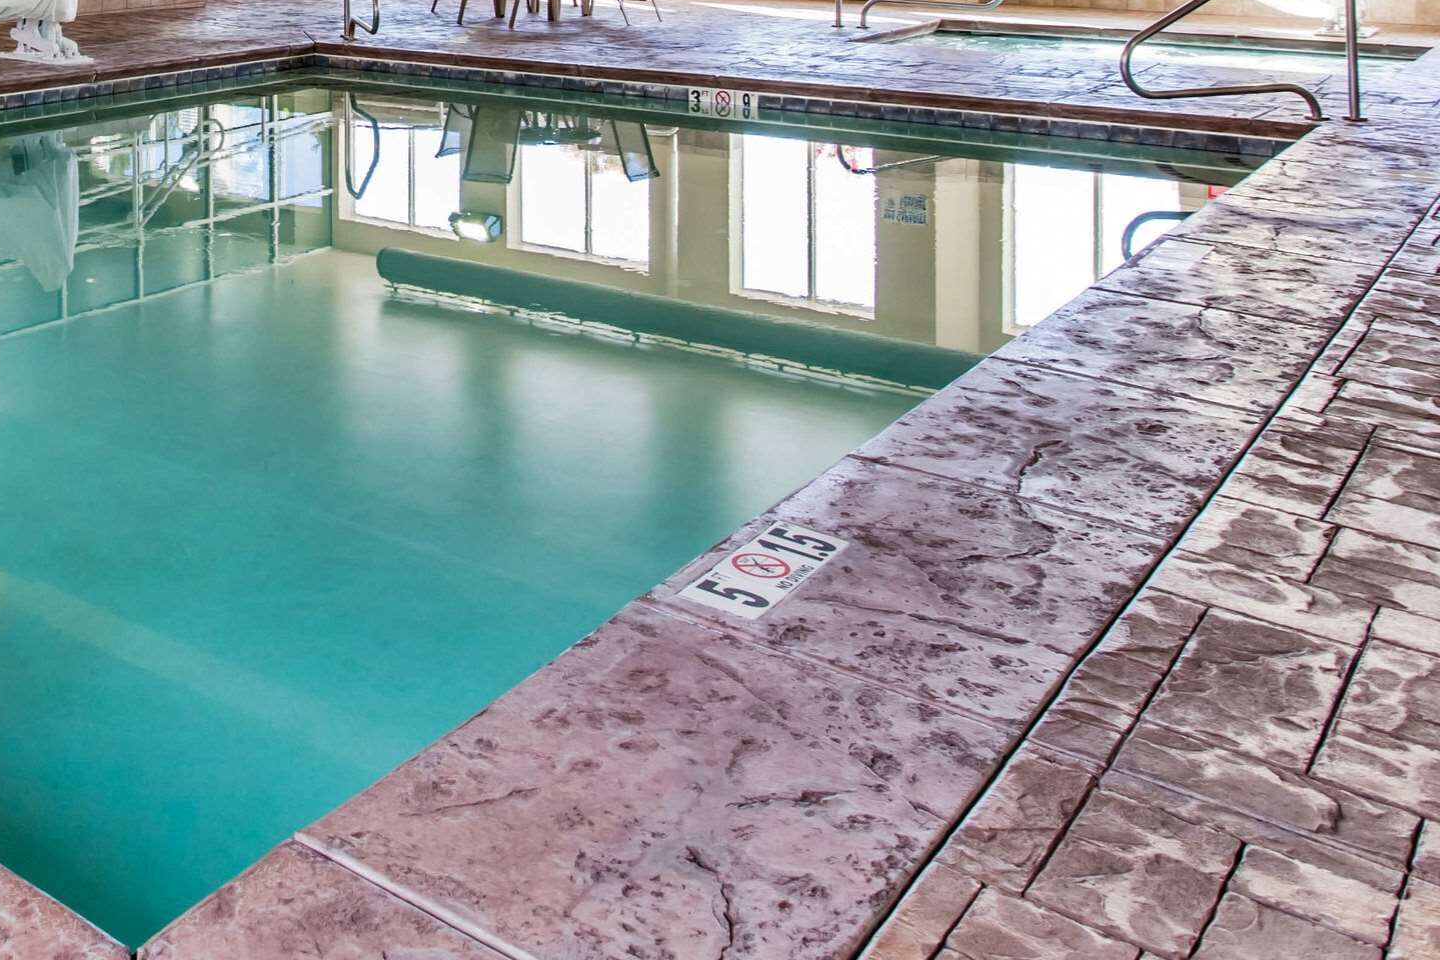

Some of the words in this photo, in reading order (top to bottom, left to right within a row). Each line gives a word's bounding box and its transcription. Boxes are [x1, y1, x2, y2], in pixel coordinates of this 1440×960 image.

[696, 579, 770, 608] 5
[757, 527, 837, 562] 1.5
[775, 580, 793, 589] NO
[785, 564, 815, 583] DIVING
